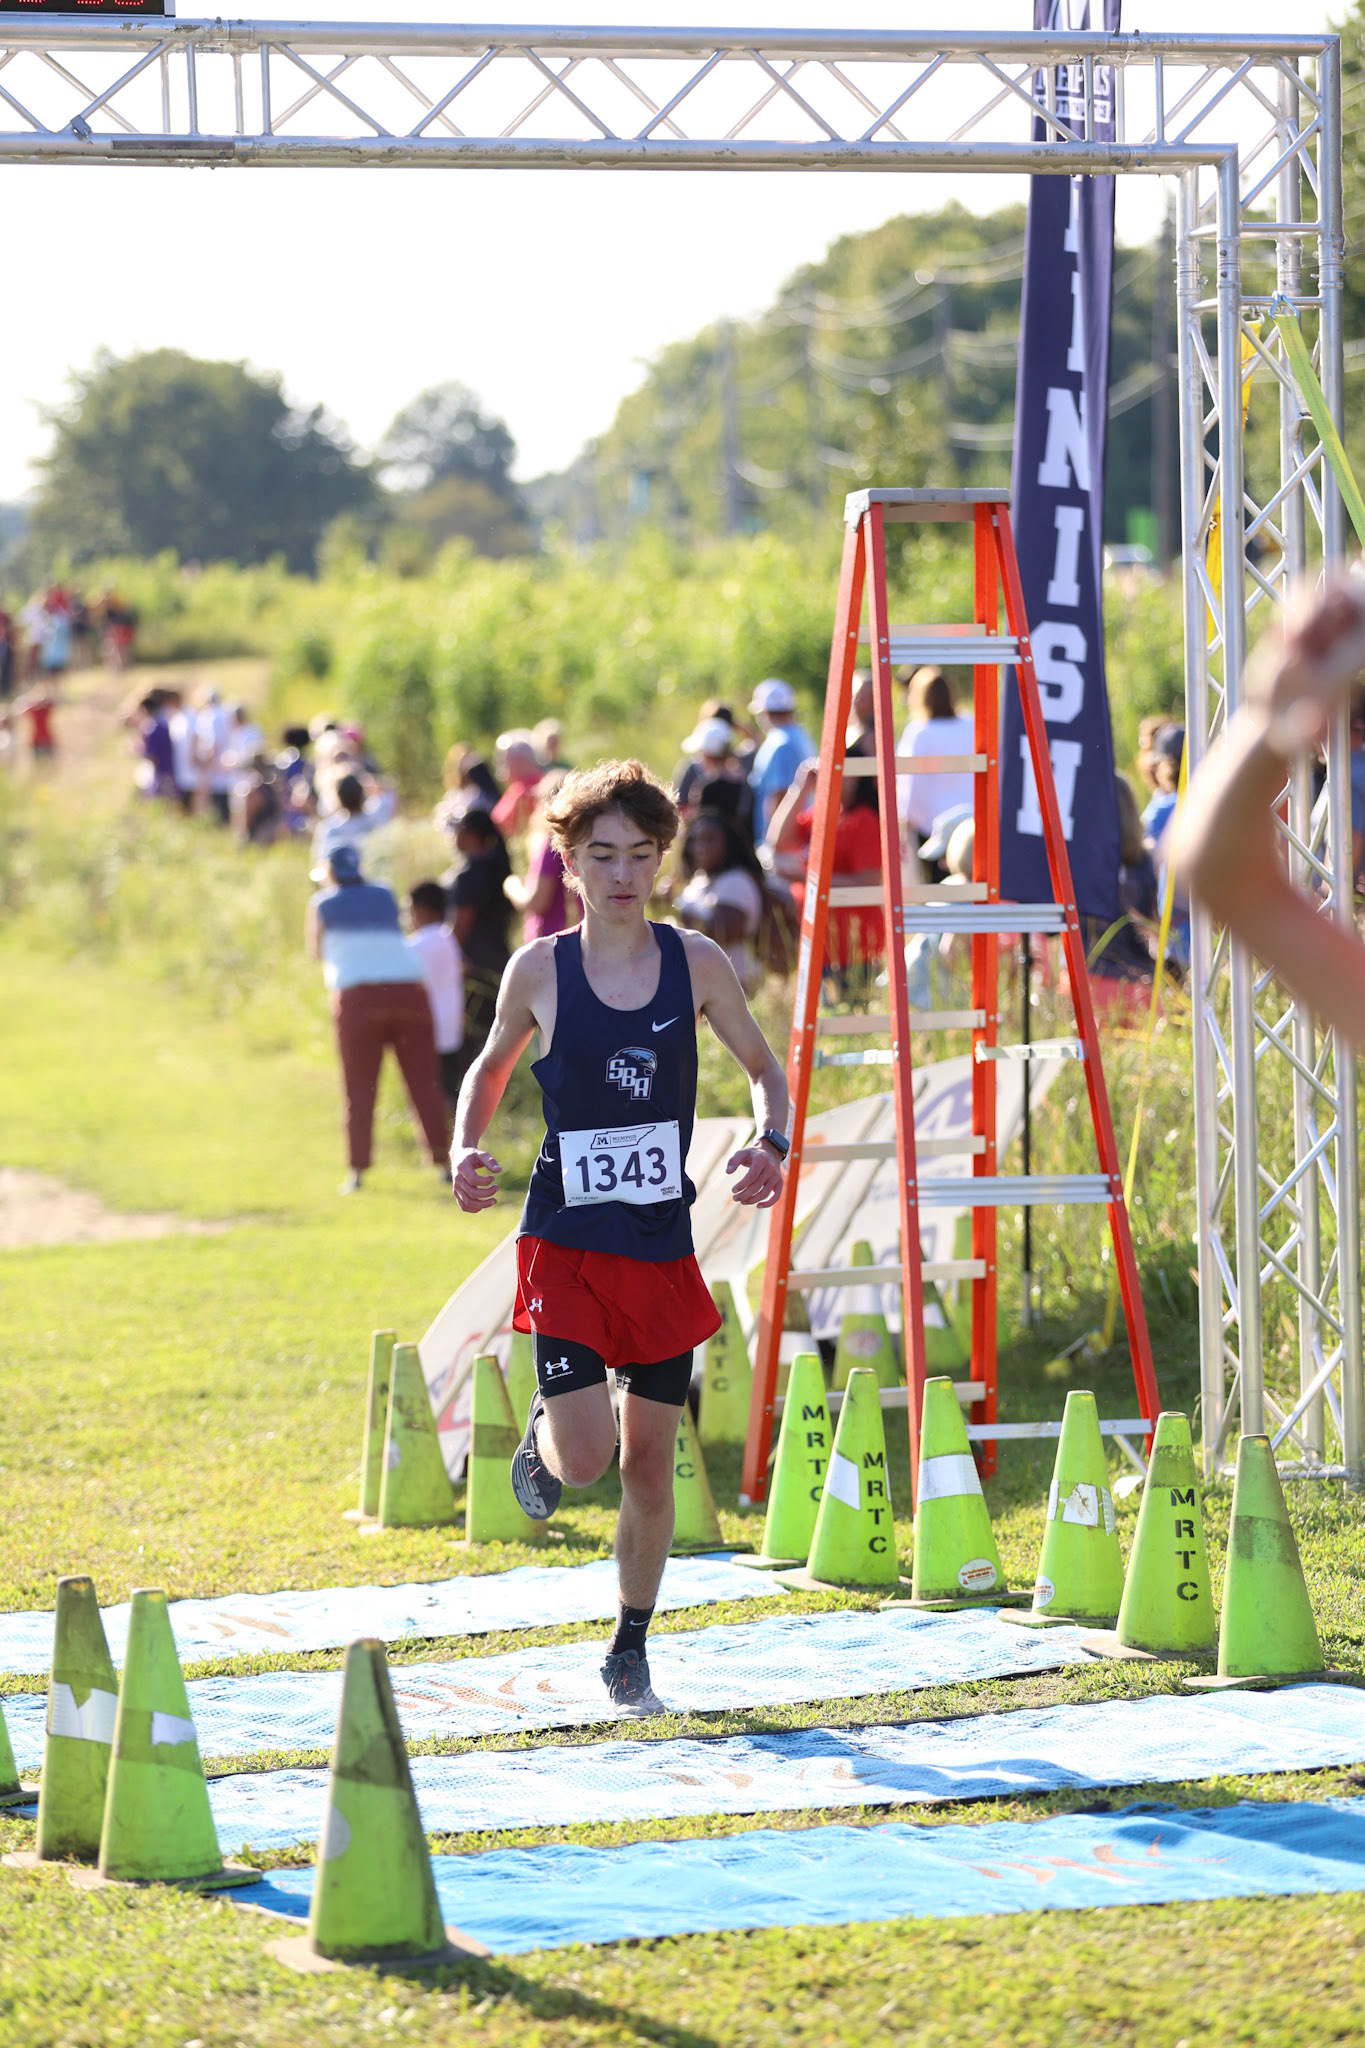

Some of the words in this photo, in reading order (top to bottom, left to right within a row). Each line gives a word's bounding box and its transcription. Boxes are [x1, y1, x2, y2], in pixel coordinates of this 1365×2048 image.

[608, 1058, 650, 1098] SBA
[575, 1146, 667, 1193] 1343
[863, 1451, 888, 1555] MRTC
[1170, 1487, 1199, 1602] MRTC
